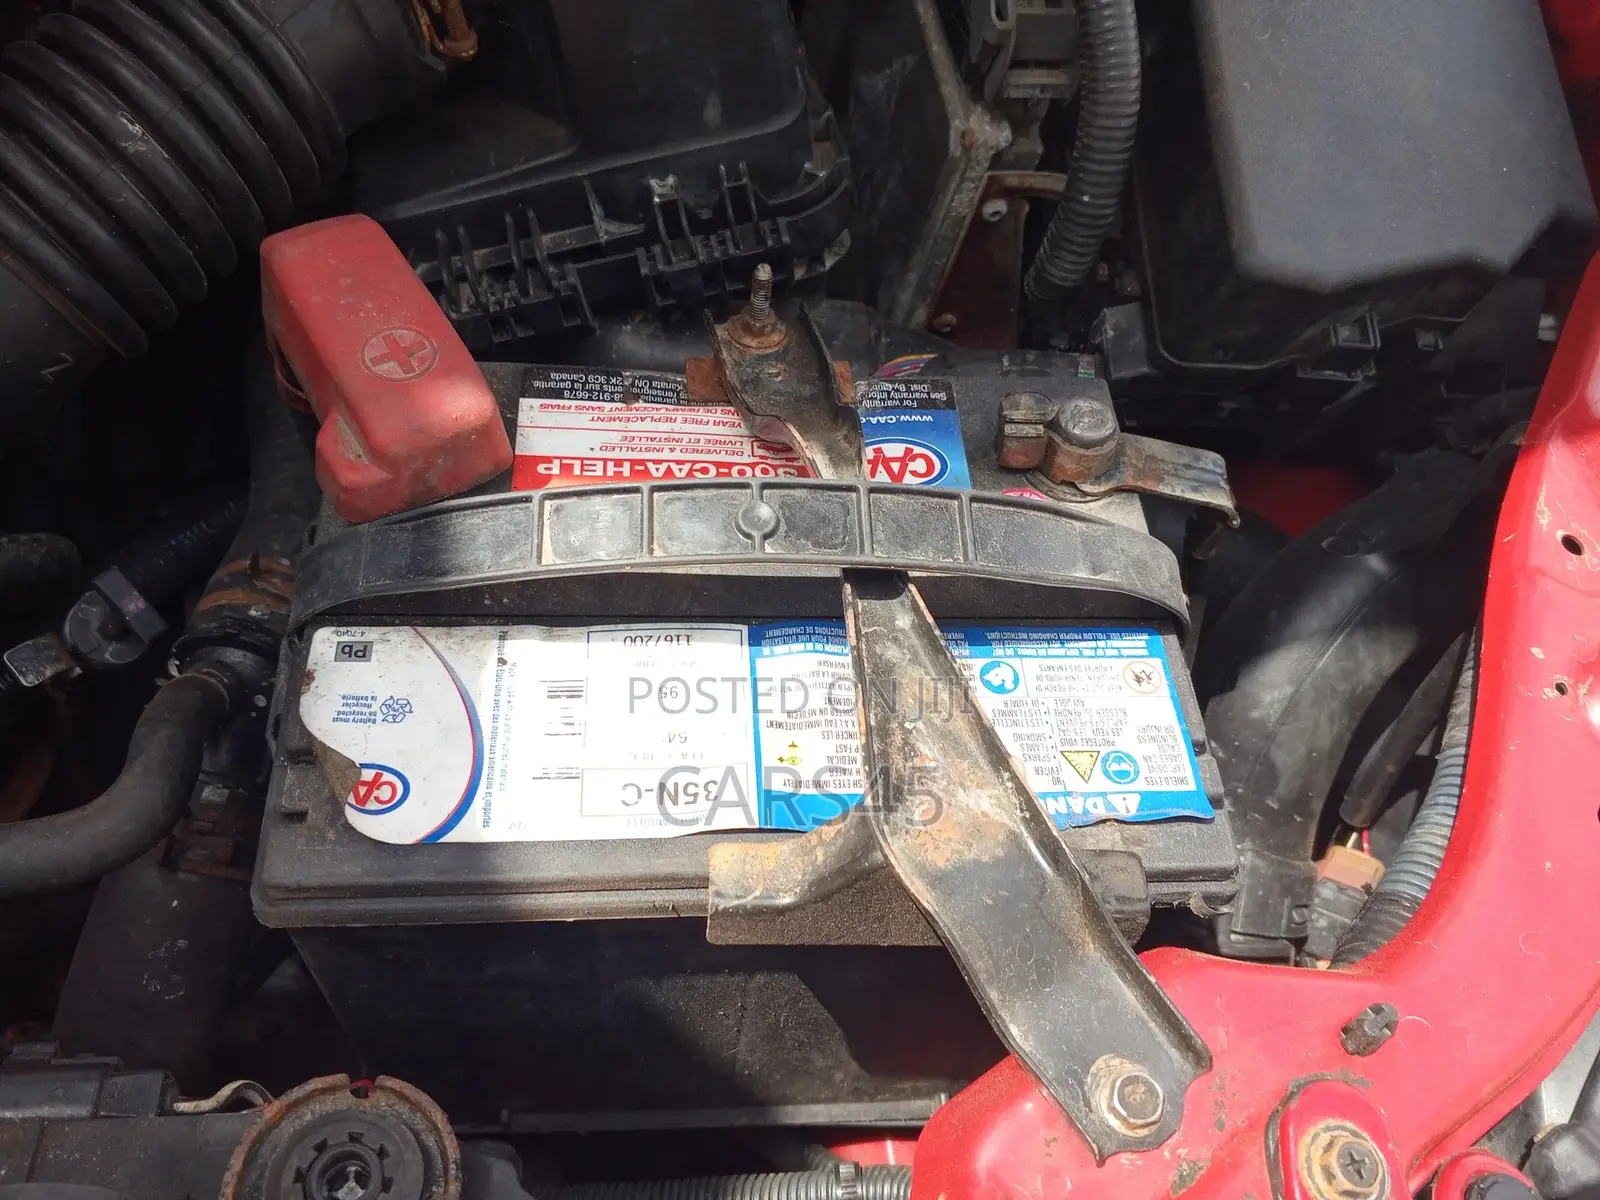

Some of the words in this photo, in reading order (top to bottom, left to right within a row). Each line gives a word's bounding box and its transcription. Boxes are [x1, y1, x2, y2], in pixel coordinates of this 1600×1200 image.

[550, 373, 585, 382] Canada
[588, 375, 607, 384] 3C9
[574, 382, 582, 390] la
[635, 379, 650, 388] ON
[894, 382, 906, 391] By
[564, 390, 623, 400] 8-912-6678
[890, 390, 928, 400] warranty
[930, 392, 947, 400] See
[862, 398, 900, 408] warranty
[903, 400, 917, 408] For
[574, 404, 606, 412] SANS
[608, 405, 701, 414] REMPLACEMENT
[588, 415, 677, 424] REPLACEMENT
[680, 416, 710, 426] FREE
[713, 420, 742, 428] YEAR
[599, 445, 664, 453] INSTALLED
[680, 447, 744, 457] DELIVERED
[764, 626, 804, 637] CHARGEMENT.
[805, 626, 813, 634] DE
[797, 634, 809, 643] UNE
[1028, 632, 1059, 640] CHARGING
[1060, 632, 1081, 640] PROPER
[1083, 632, 1106, 640] FOLLOW
[762, 635, 796, 647] UTILISATION
[341, 644, 368, 659] Pb
[658, 686, 678, 699] 95
[819, 708, 828, 716] UN
[332, 716, 350, 724] must
[352, 715, 377, 724] Battery
[492, 713, 500, 723] des
[766, 720, 823, 730] IMMEDIATEMENT
[821, 730, 833, 739] LES
[1013, 733, 1046, 742] SMOKING
[835, 744, 852, 753] FAST
[826, 756, 857, 764] MEDICAL
[829, 768, 853, 777] WATER
[783, 778, 831, 788] IMMEDIATELY
[833, 779, 850, 788] EYES
[1144, 776, 1162, 786] EYES
[620, 780, 718, 808] 35N-C
